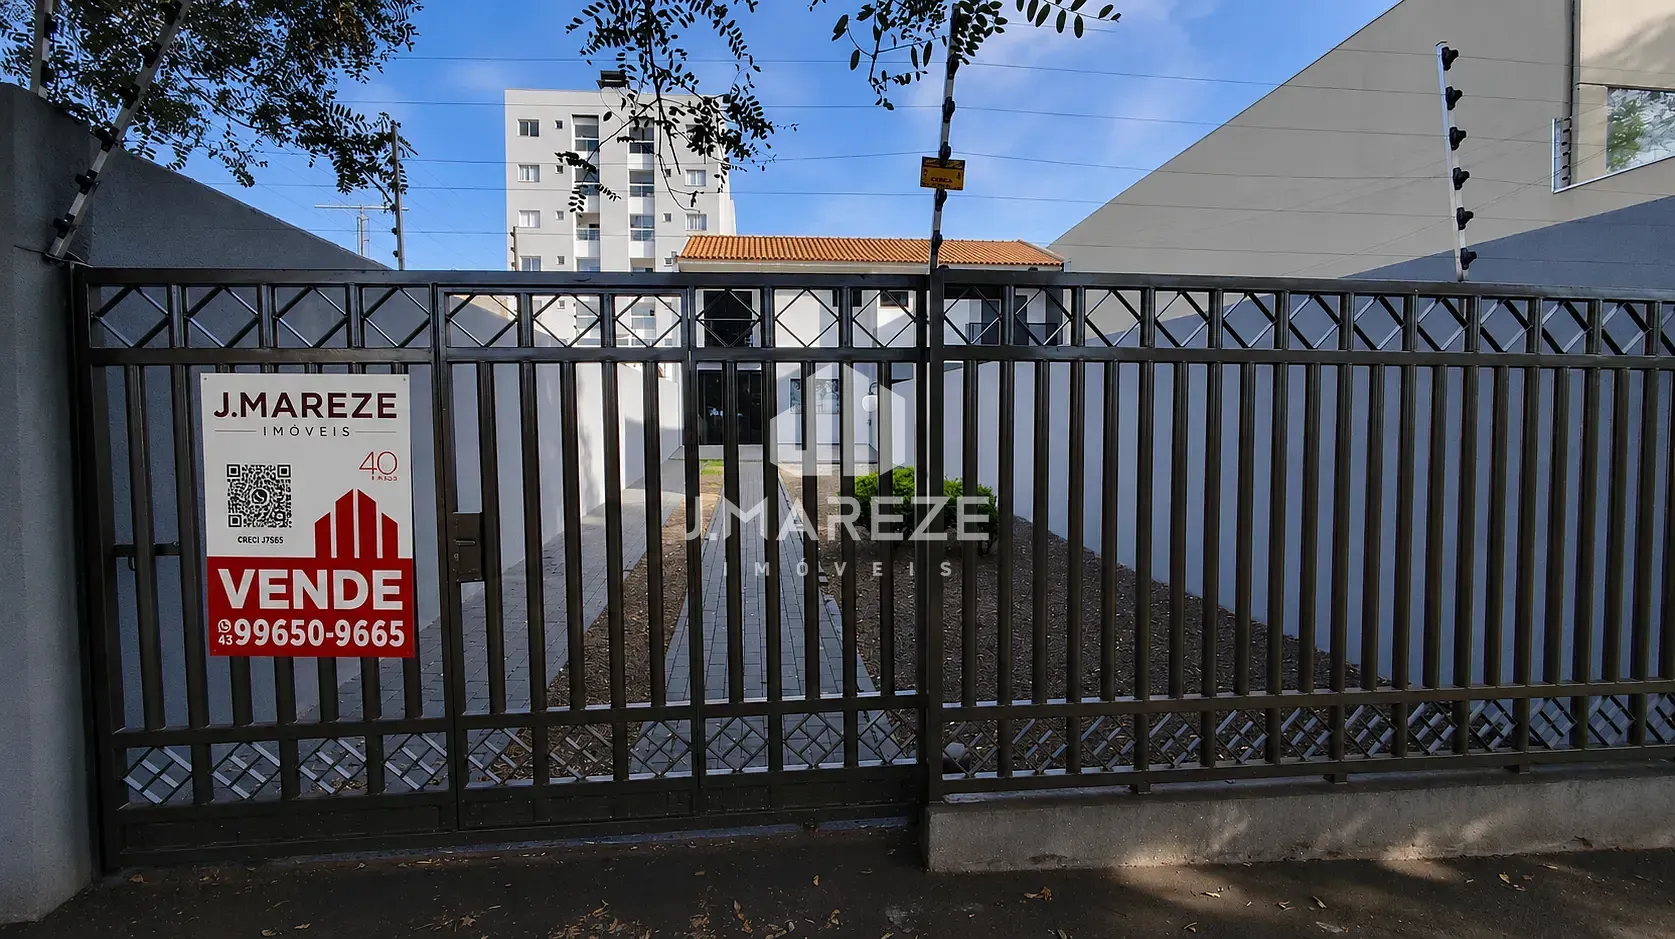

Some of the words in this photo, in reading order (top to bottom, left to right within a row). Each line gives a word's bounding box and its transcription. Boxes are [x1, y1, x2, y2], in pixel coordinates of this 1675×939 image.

[213, 391, 398, 419] J.MAREZE
[263, 424, 351, 437] IMÓVEIS
[359, 451, 398, 475] 40
[237, 535, 260, 544] CRECI
[217, 568, 404, 610] VENDE
[218, 634, 233, 646] 43
[234, 618, 405, 647] 99650-9665
